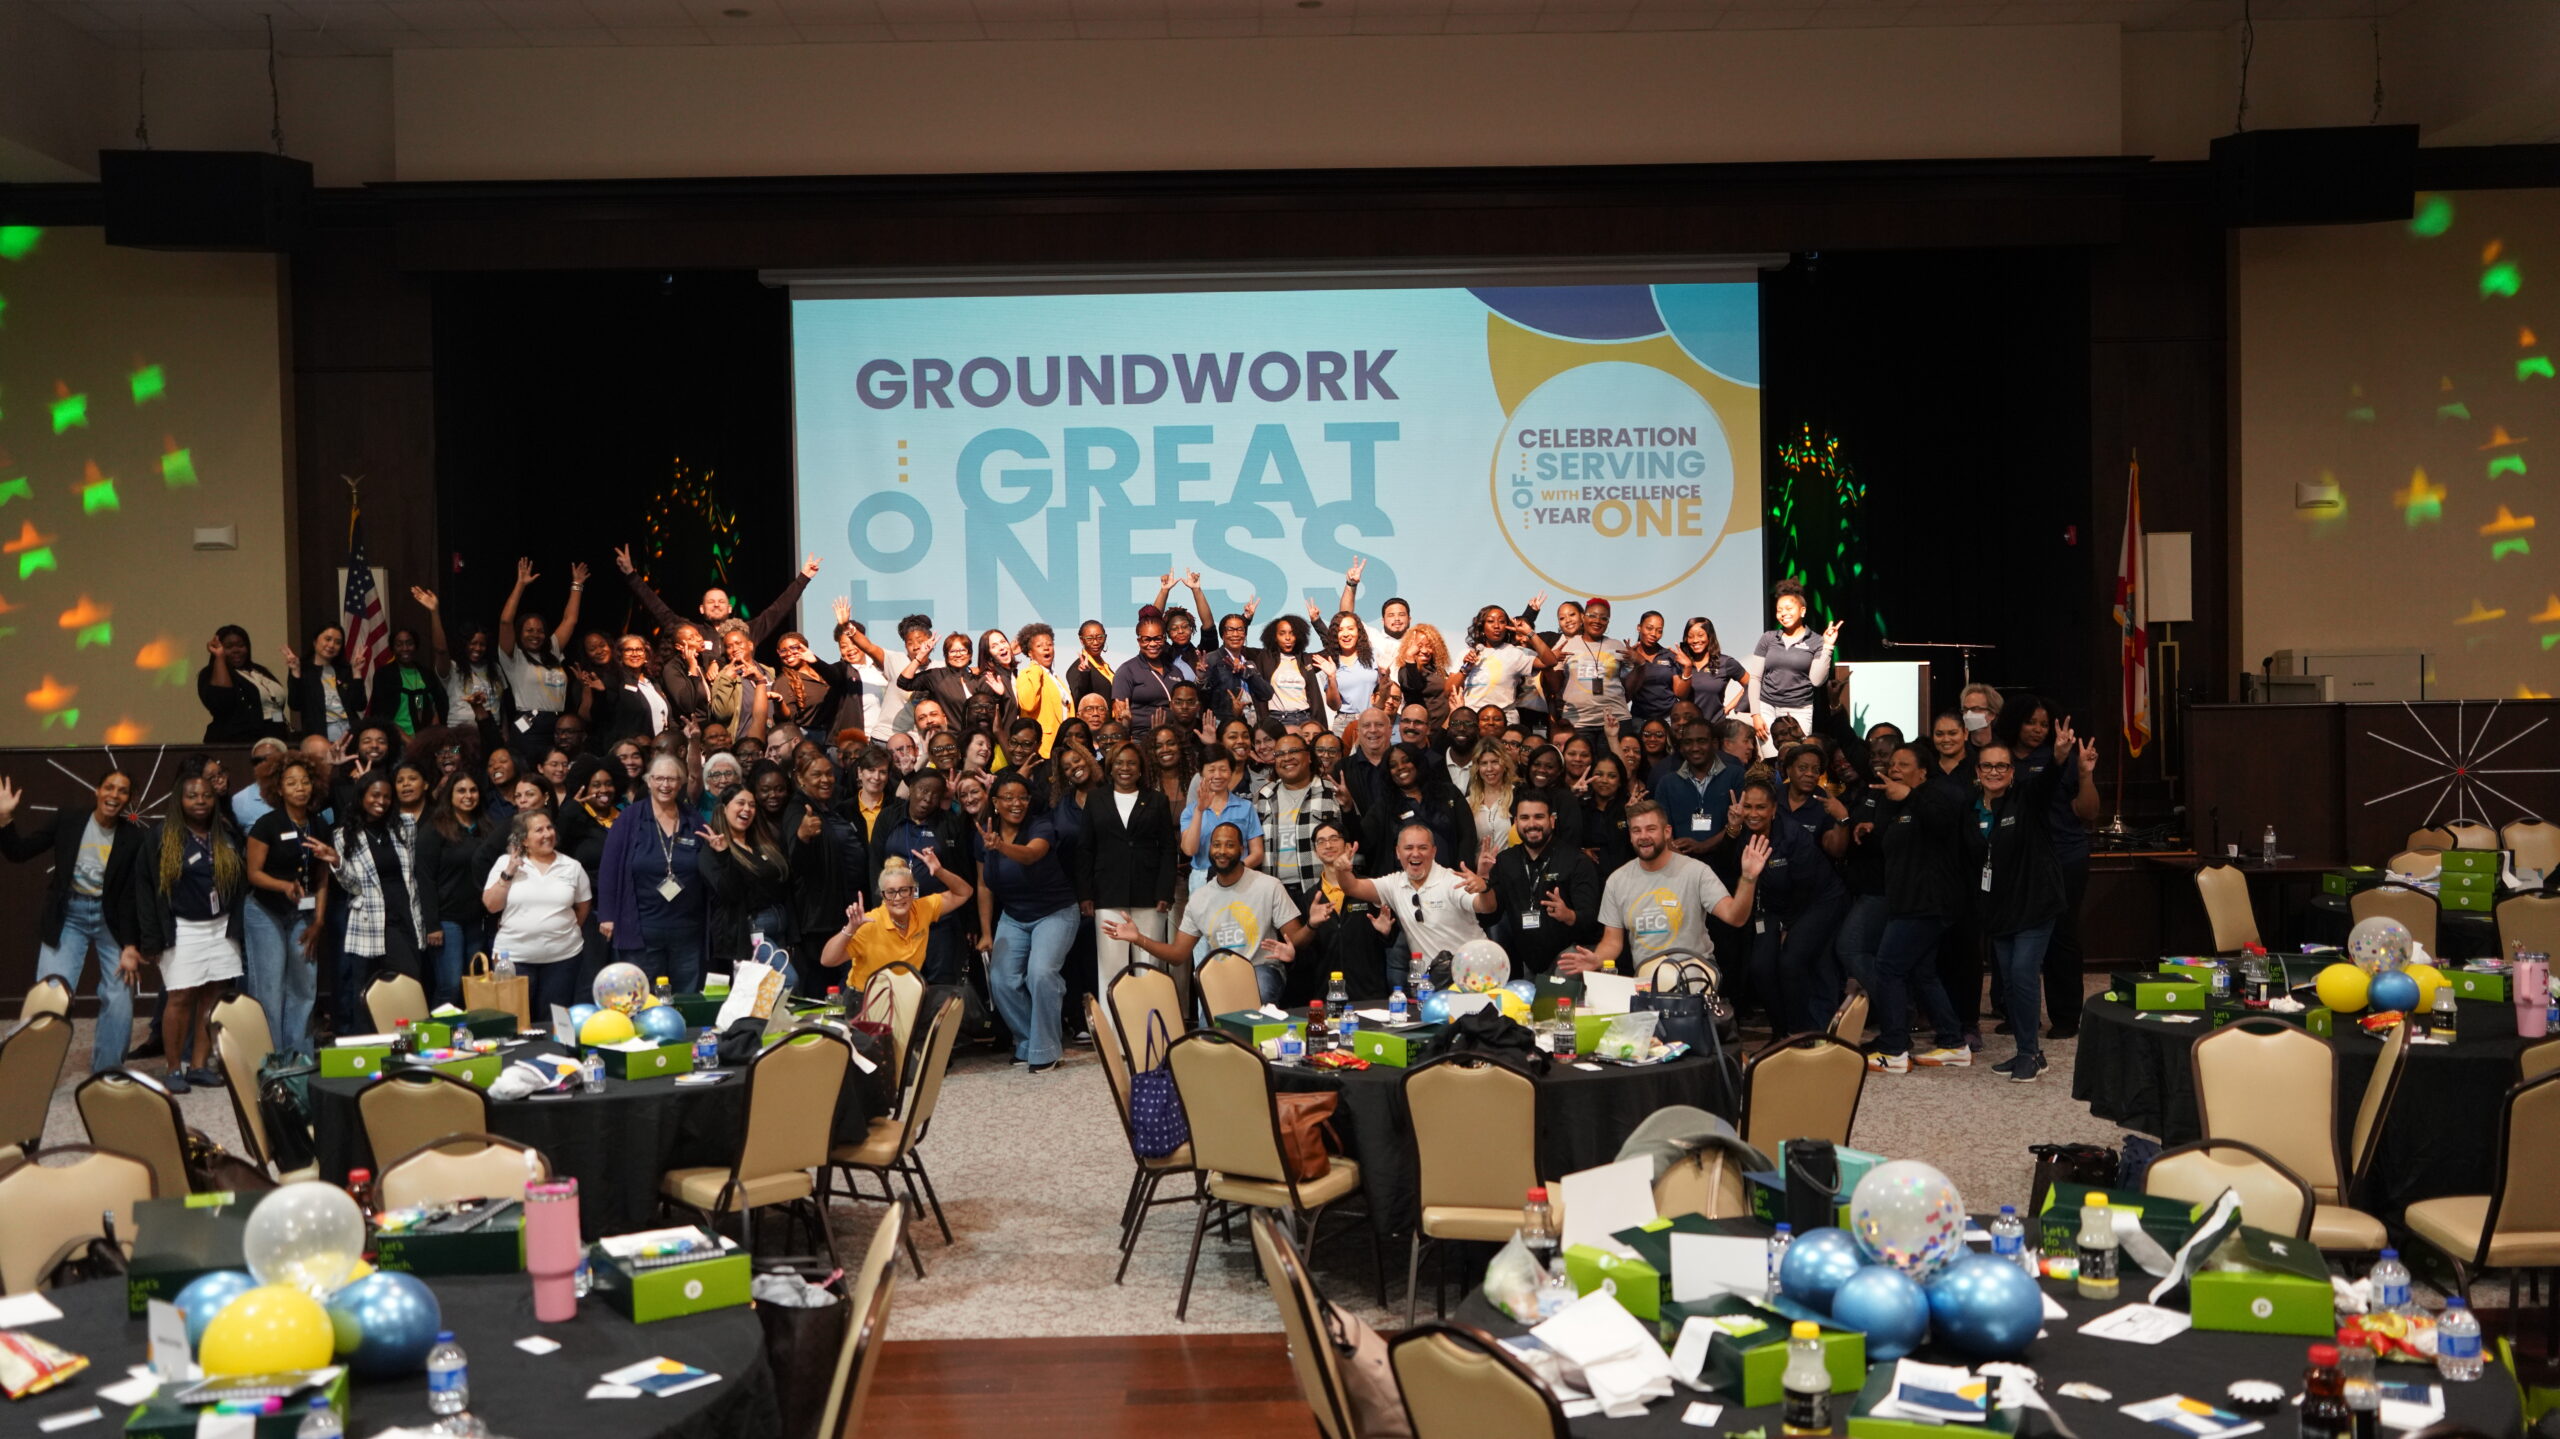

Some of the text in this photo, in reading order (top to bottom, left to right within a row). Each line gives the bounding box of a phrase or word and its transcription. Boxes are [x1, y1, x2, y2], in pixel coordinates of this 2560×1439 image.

[856, 349, 1400, 410] GROUNDWORK
[1518, 427, 1697, 448] CELEBRATION
[956, 421, 1400, 525] GREAT
[1536, 450, 1706, 481] SERVING
[1512, 473, 1533, 509] OF
[1541, 484, 1700, 501] WITH EXCELLENCE
[1533, 498, 1703, 538] YEAR ONE
[848, 491, 934, 636] TO
[964, 499, 1398, 631] NESS
[1635, 914, 1667, 931] EEC
[1216, 928, 1244, 946] EEC
[2043, 1223, 2070, 1238] Let's
[379, 1240, 405, 1252] Let's
[2043, 1236, 2060, 1247] do
[130, 1279, 160, 1291] Let's
